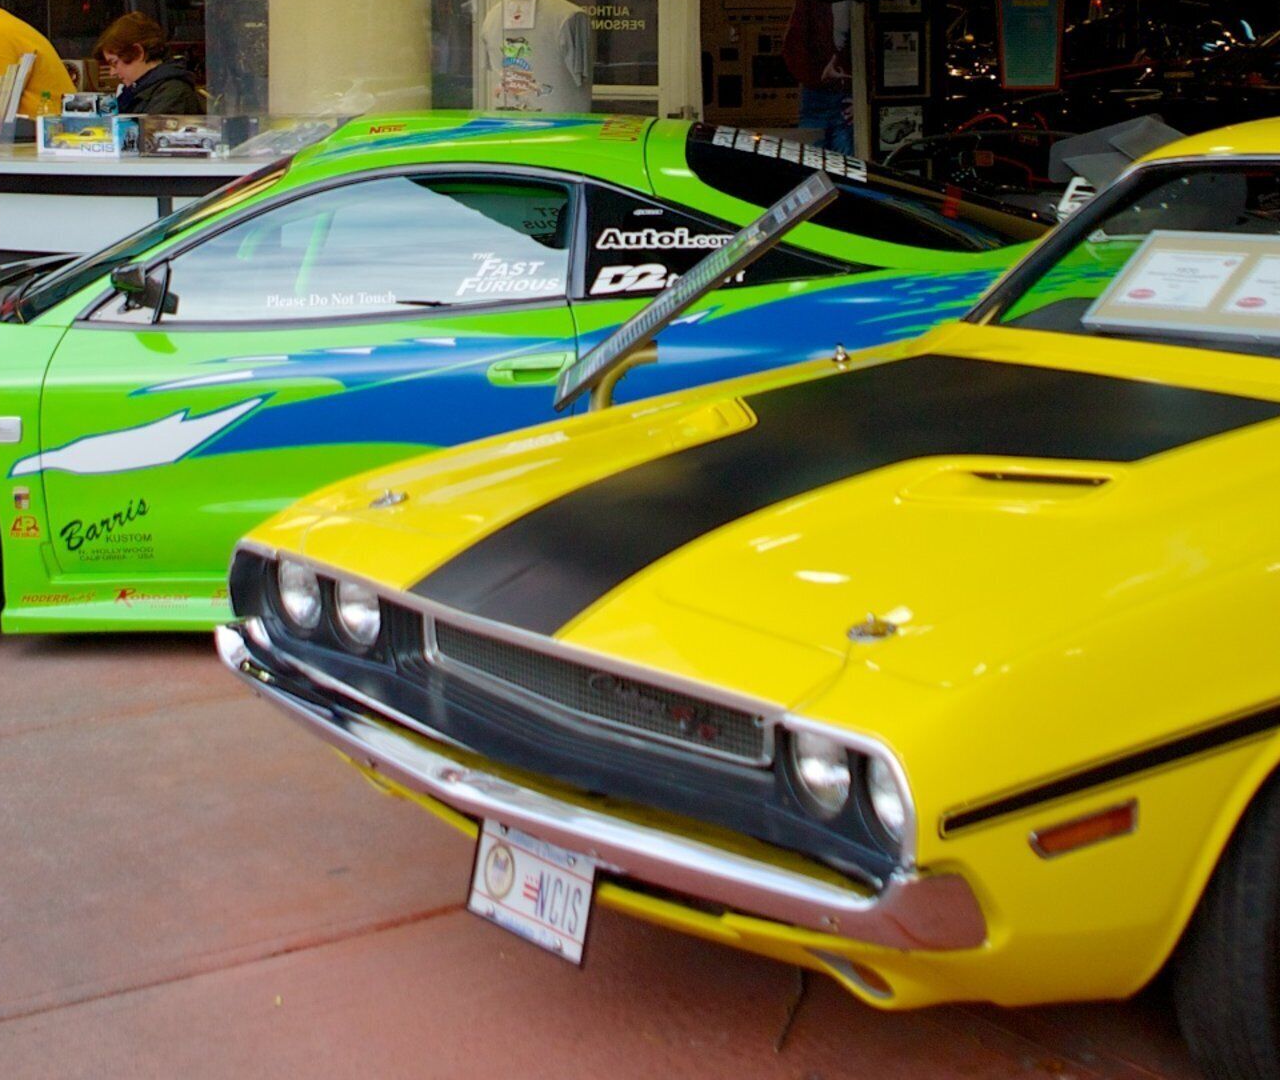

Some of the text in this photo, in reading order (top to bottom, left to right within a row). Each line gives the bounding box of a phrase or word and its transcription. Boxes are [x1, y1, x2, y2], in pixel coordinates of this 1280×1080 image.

[79, 143, 115, 153] NCIS
[472, 251, 495, 260] THE
[476, 258, 546, 277] FAST
[455, 277, 560, 297] FURIOUS
[266, 290, 396, 307] Please Do Not Touch
[60, 496, 151, 552] Barris
[105, 533, 153, 543] KUSTOM
[91, 546, 154, 555] HOLLYWOOD
[79, 553, 127, 562] CALIFORNIA
[21, 592, 69, 604] MODERN
[535, 869, 583, 936] NCIS
